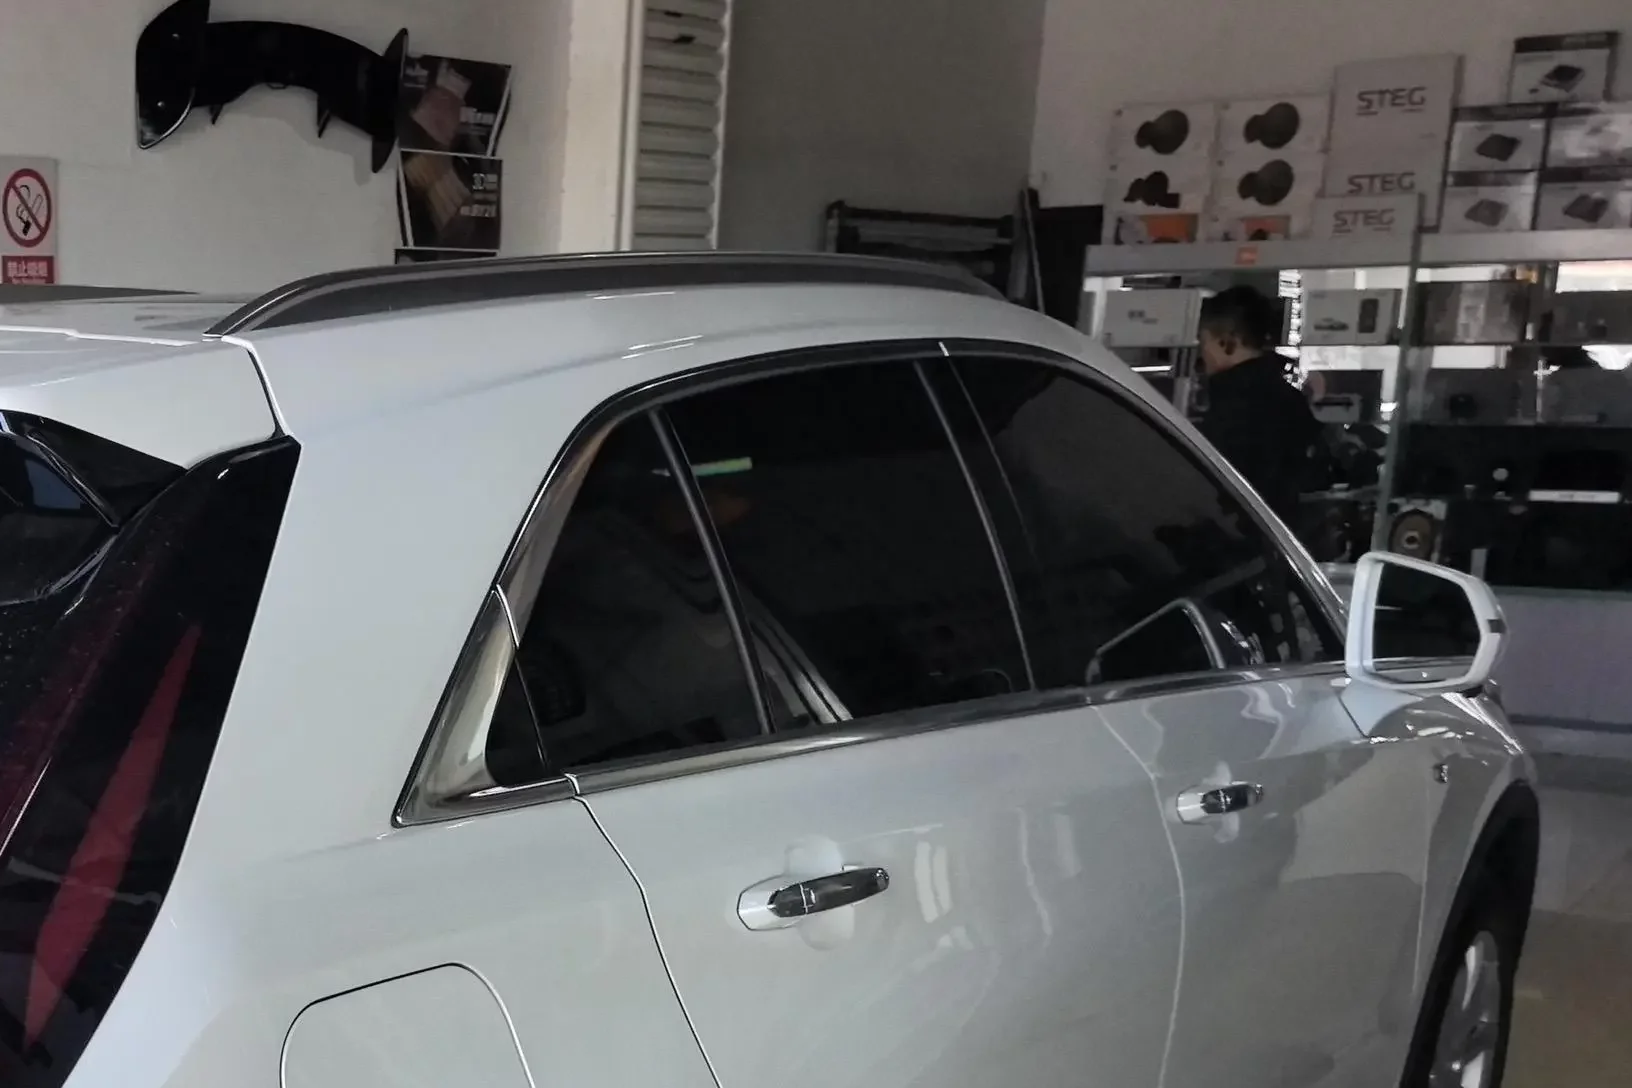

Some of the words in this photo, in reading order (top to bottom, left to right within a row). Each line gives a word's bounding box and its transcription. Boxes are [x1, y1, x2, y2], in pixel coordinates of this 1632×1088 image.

[1356, 87, 1426, 114] STEG
[1348, 172, 1415, 194] STEG
[1333, 209, 1394, 231] STEG
